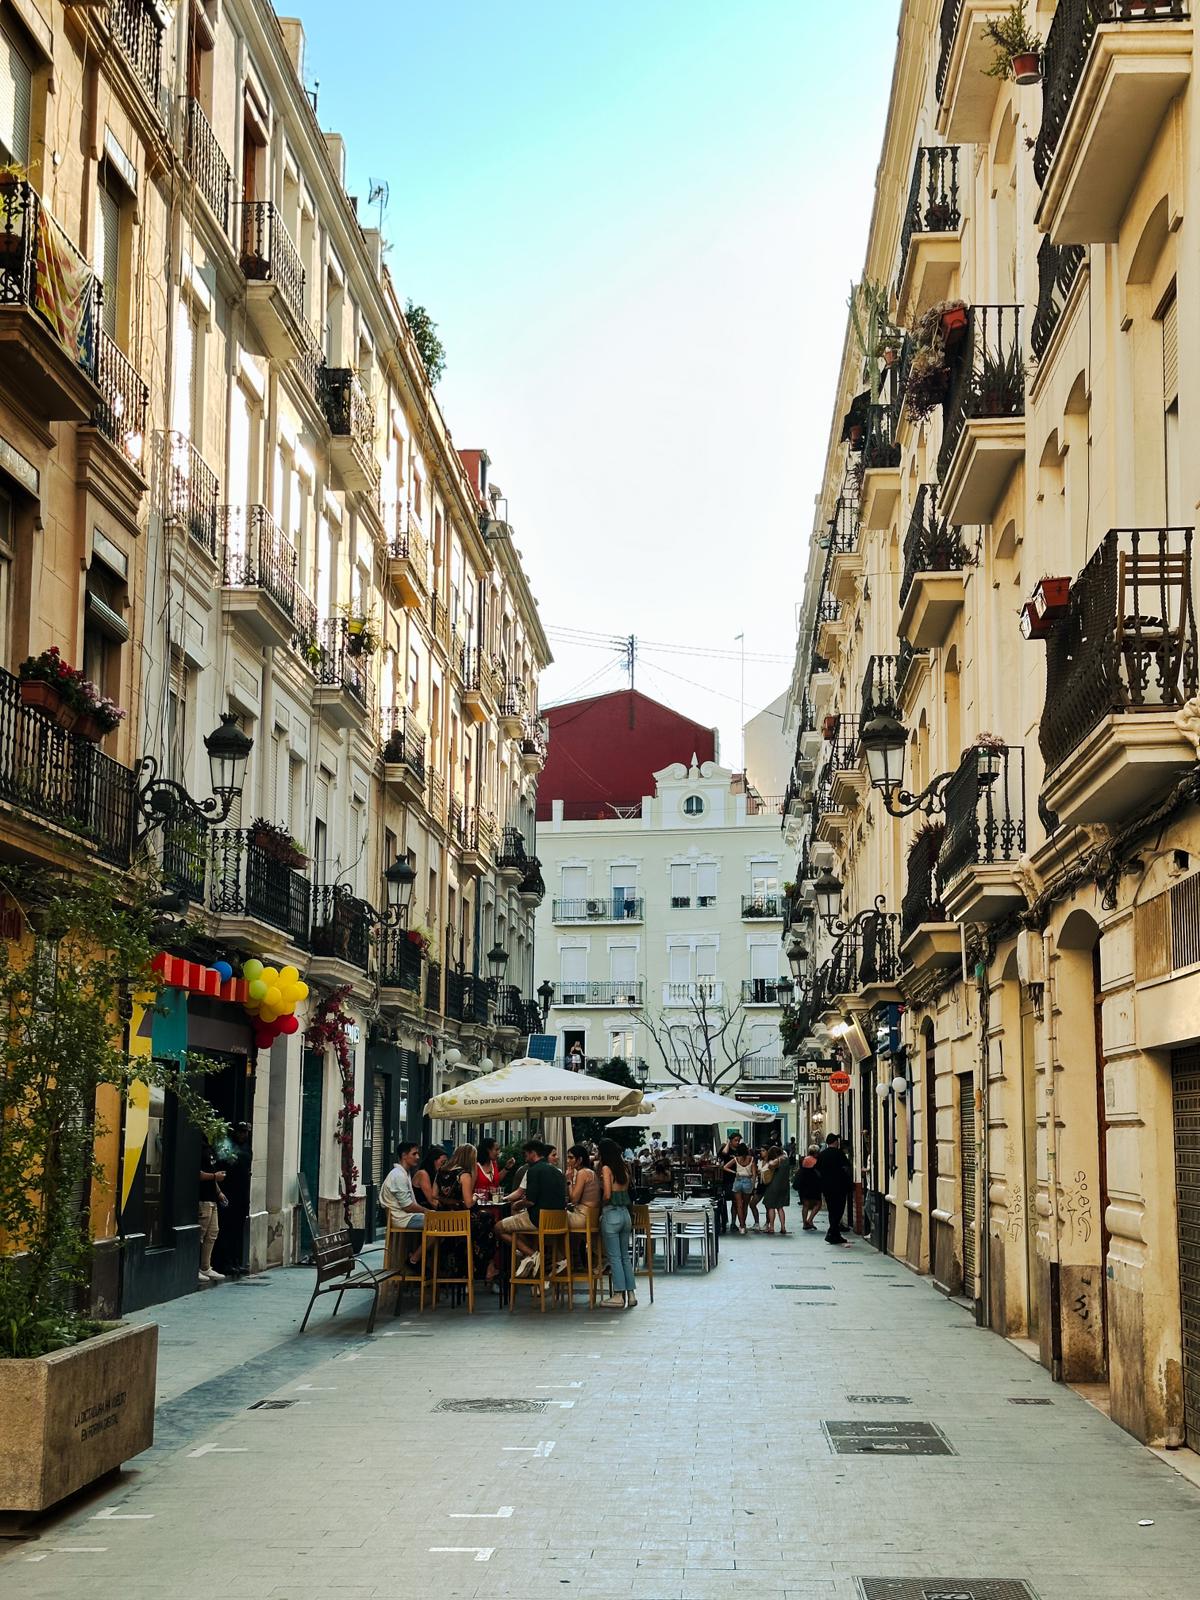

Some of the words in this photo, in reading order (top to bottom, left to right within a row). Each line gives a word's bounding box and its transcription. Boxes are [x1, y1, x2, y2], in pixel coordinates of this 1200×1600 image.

[463, 1098, 479, 1106] Este
[479, 1096, 505, 1105] parasol
[505, 1094, 542, 1103] contribuye
[549, 1094, 562, 1102] que
[563, 1093, 590, 1102] respires
